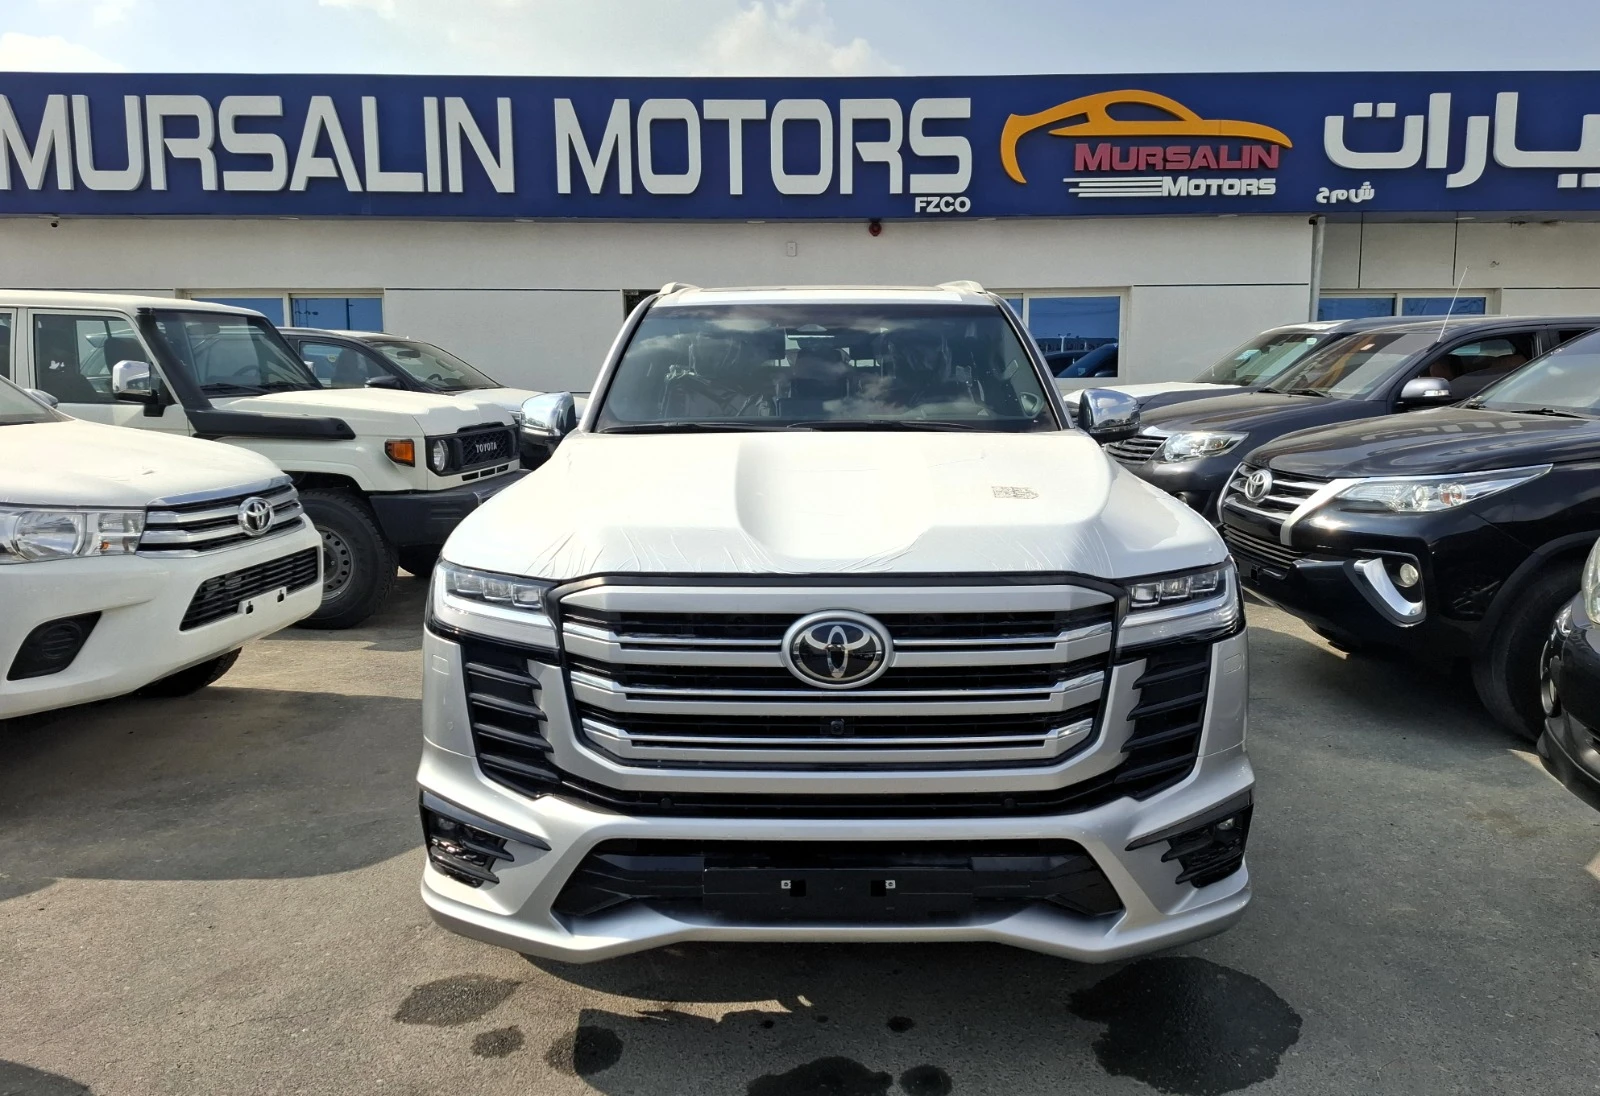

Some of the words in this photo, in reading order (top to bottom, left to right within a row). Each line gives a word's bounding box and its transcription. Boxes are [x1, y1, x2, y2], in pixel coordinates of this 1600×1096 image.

[0, 94, 515, 193] MURSALIN
[554, 97, 972, 195] MOTORS
[1074, 143, 1280, 172] MURSALIN
[1162, 176, 1277, 197] MOTORS
[914, 196, 971, 213] FZCO
[475, 441, 498, 453] TOYOTA
